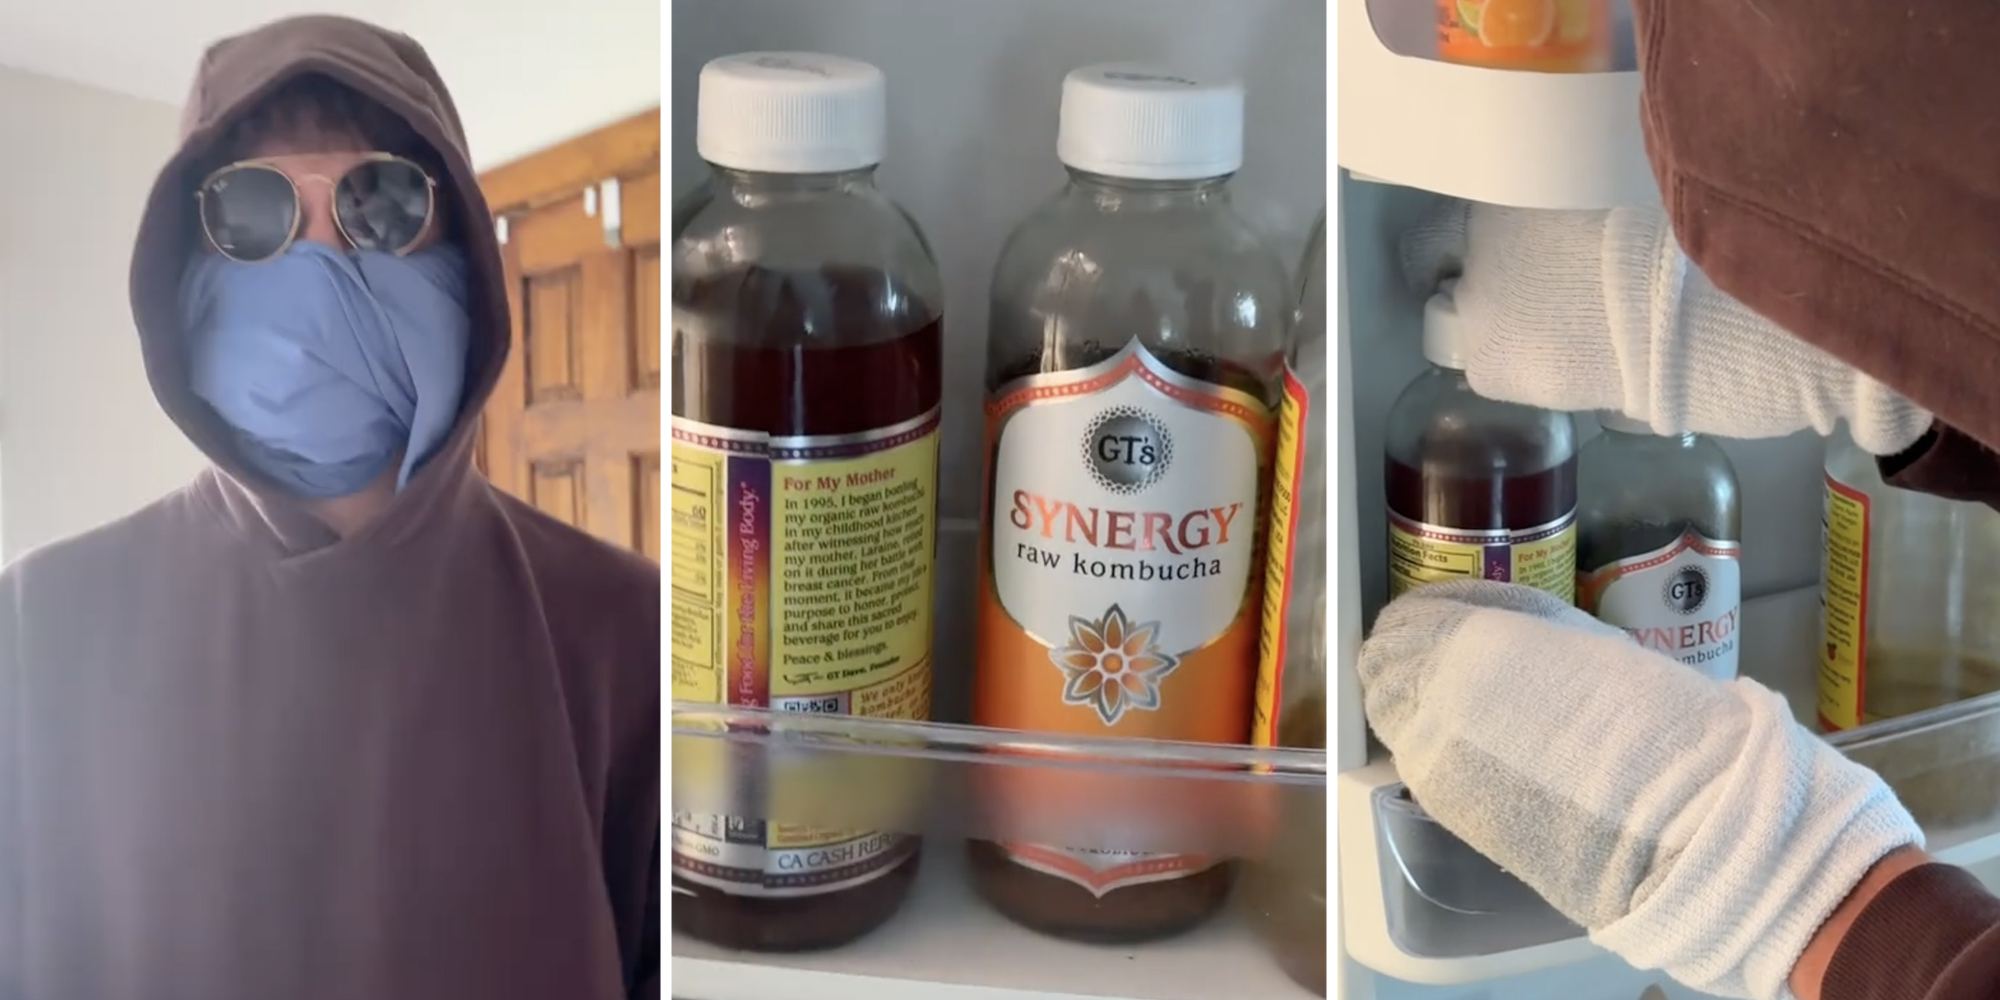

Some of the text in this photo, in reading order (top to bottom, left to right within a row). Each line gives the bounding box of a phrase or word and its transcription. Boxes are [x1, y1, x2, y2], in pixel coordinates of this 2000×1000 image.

[1098, 434, 1155, 465] GT's
[784, 468, 896, 492] For My Mother
[785, 499, 799, 509] In
[849, 490, 882, 506] began
[785, 513, 806, 526] my
[809, 508, 856, 524] organic
[859, 503, 880, 517] raw
[1010, 489, 1239, 555] SYNERGY
[784, 540, 815, 551] after
[819, 531, 880, 551] witnessing
[882, 525, 902, 539] how
[785, 526, 798, 538] in
[801, 526, 821, 539] my
[825, 516, 883, 535] childhood
[784, 568, 801, 578] on
[805, 566, 813, 577] it
[817, 563, 857, 577] during
[860, 558, 879, 571] her
[785, 553, 806, 567] my
[1017, 543, 1221, 580] raw kombucha
[1422, 549, 1448, 563] Facts
[1518, 553, 1534, 563] For
[1536, 549, 1547, 560] My
[784, 580, 824, 591] breast
[872, 566, 899, 582] From
[844, 590, 852, 601] it
[855, 581, 896, 598] became
[784, 606, 836, 621] purpose
[839, 604, 851, 615] to
[784, 602, 902, 633] and share this sacred
[784, 631, 841, 647] beverage
[843, 629, 860, 641] for
[862, 623, 883, 640] you
[885, 620, 895, 631] to
[1621, 606, 1737, 651] YNERGY
[784, 653, 821, 665] Peace
[824, 651, 834, 662] &
[1673, 640, 1733, 665] mbucha
[778, 852, 803, 870] CA
[806, 845, 854, 869] CASH
